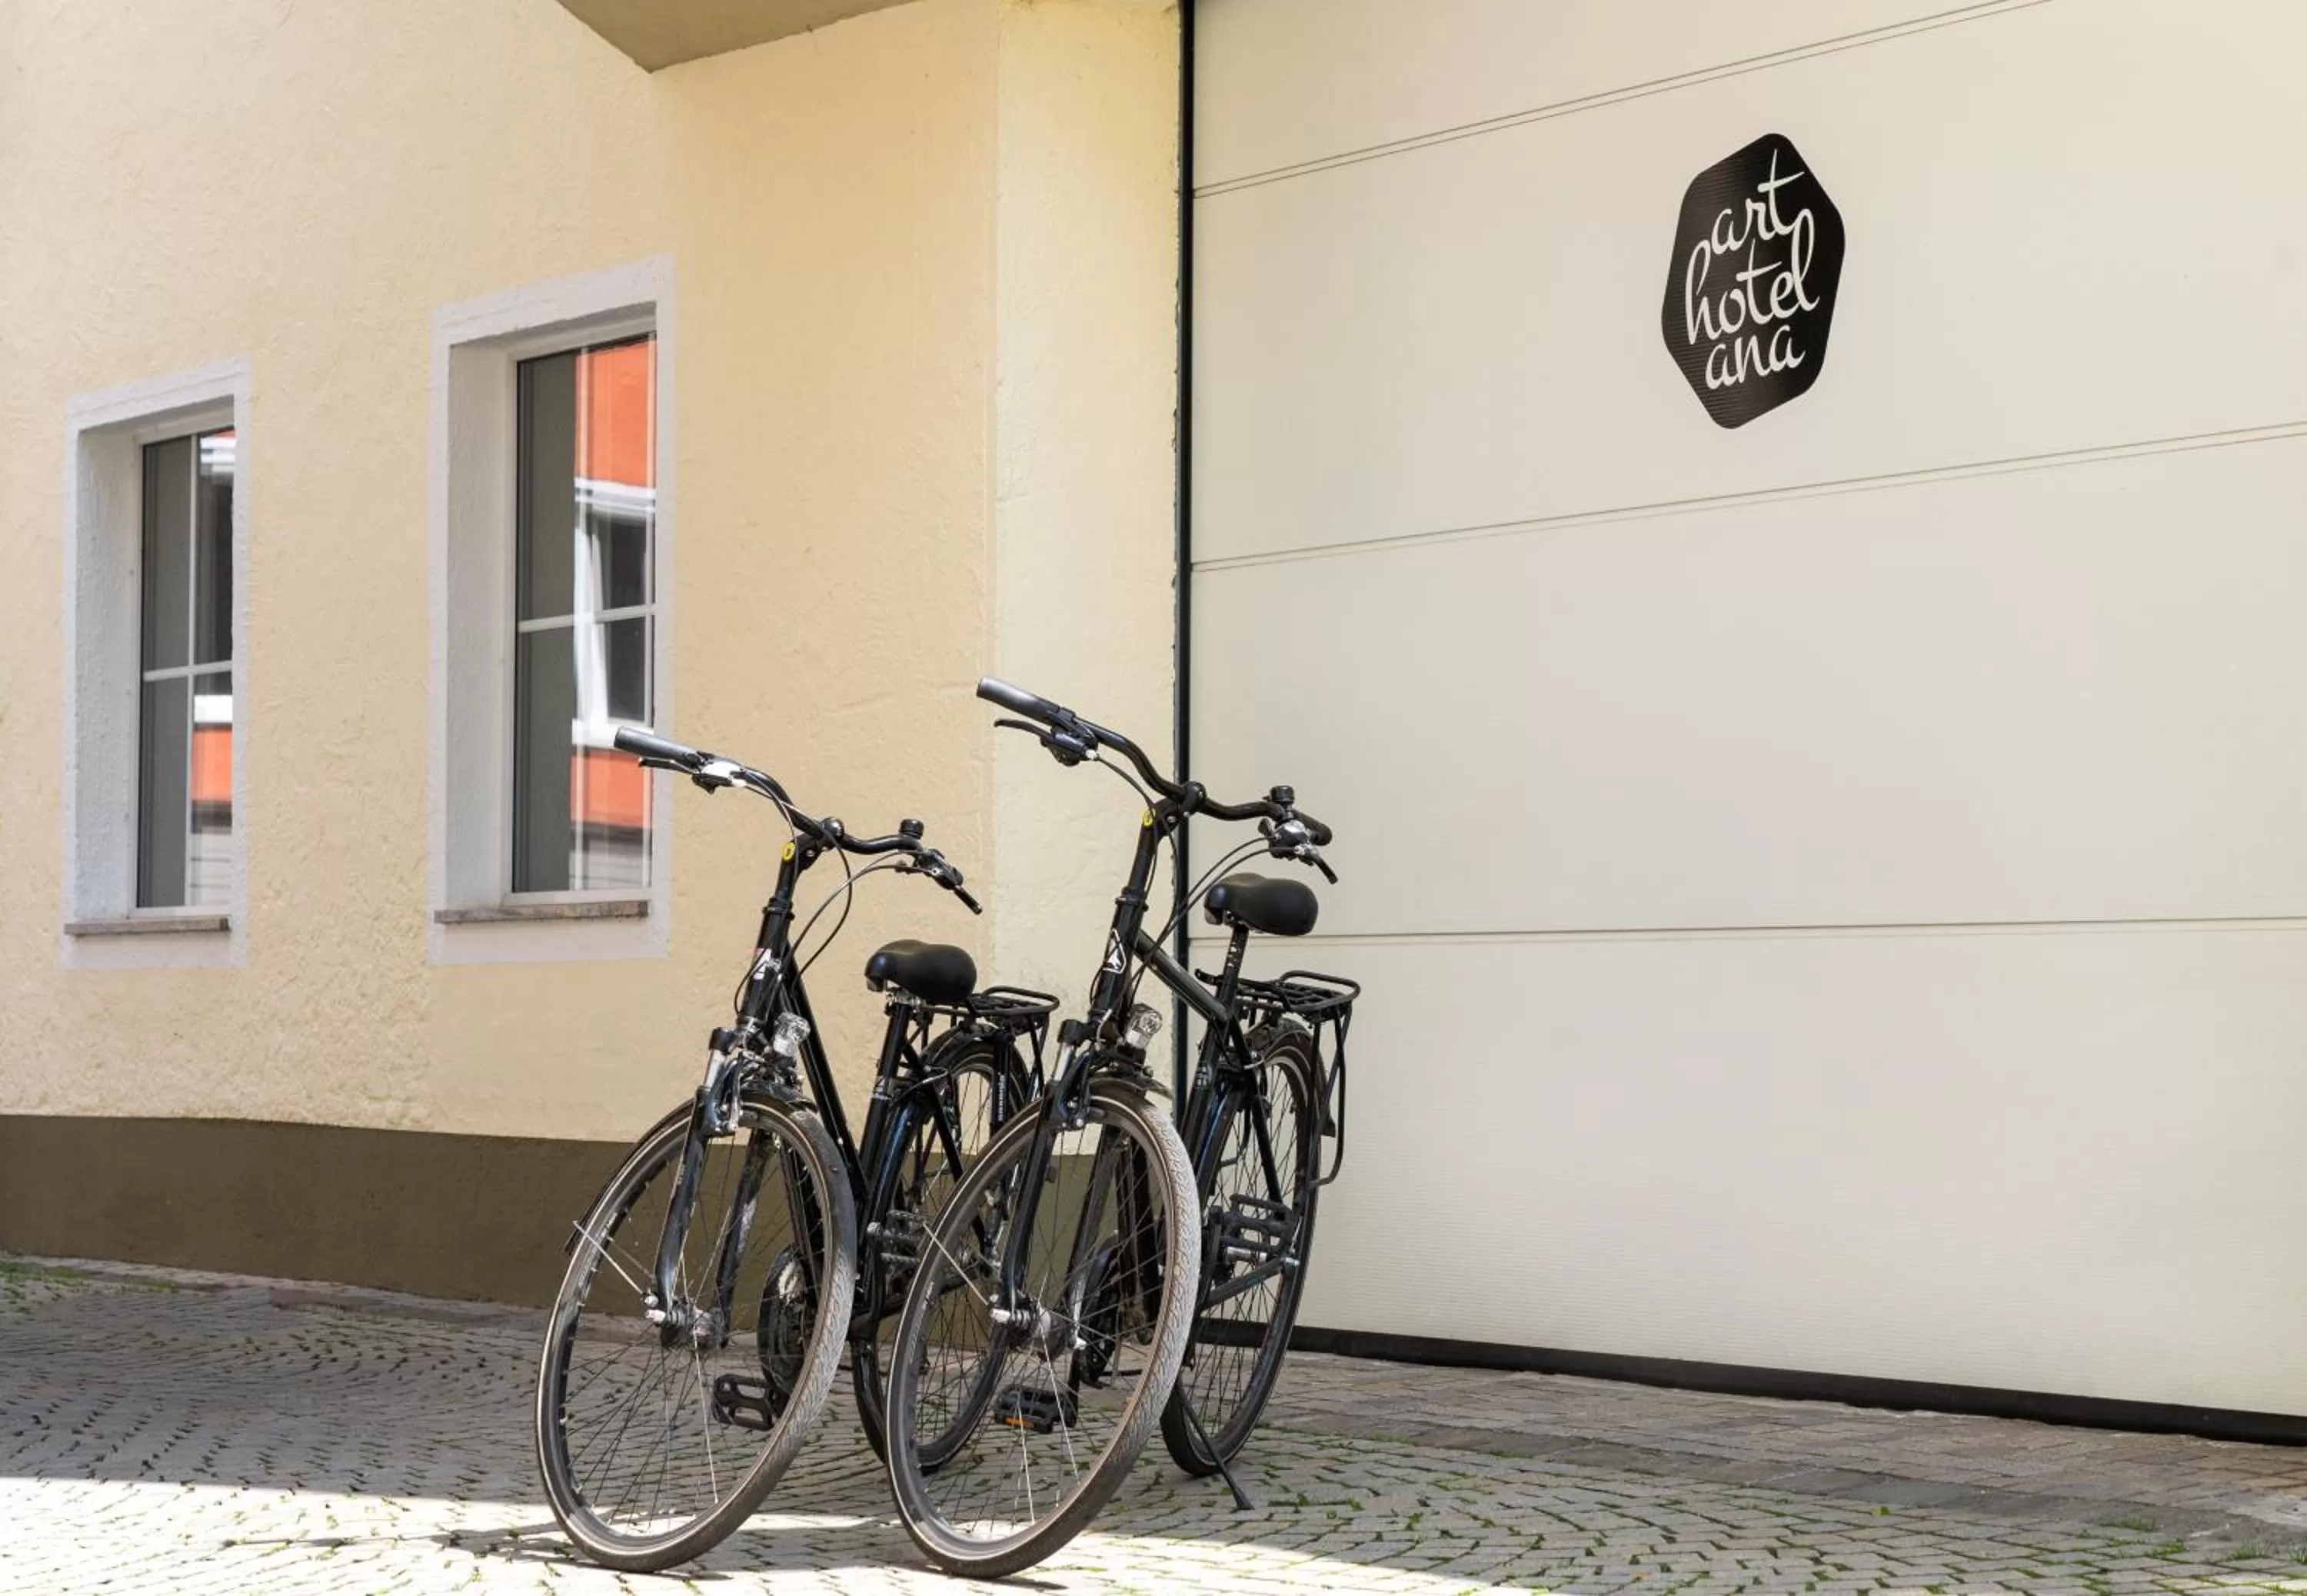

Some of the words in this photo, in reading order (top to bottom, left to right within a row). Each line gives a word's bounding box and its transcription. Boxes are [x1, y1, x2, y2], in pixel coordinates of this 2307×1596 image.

[1711, 148, 1805, 254] art
[1685, 208, 1819, 344] hotel
[1705, 325, 1806, 390] ana
